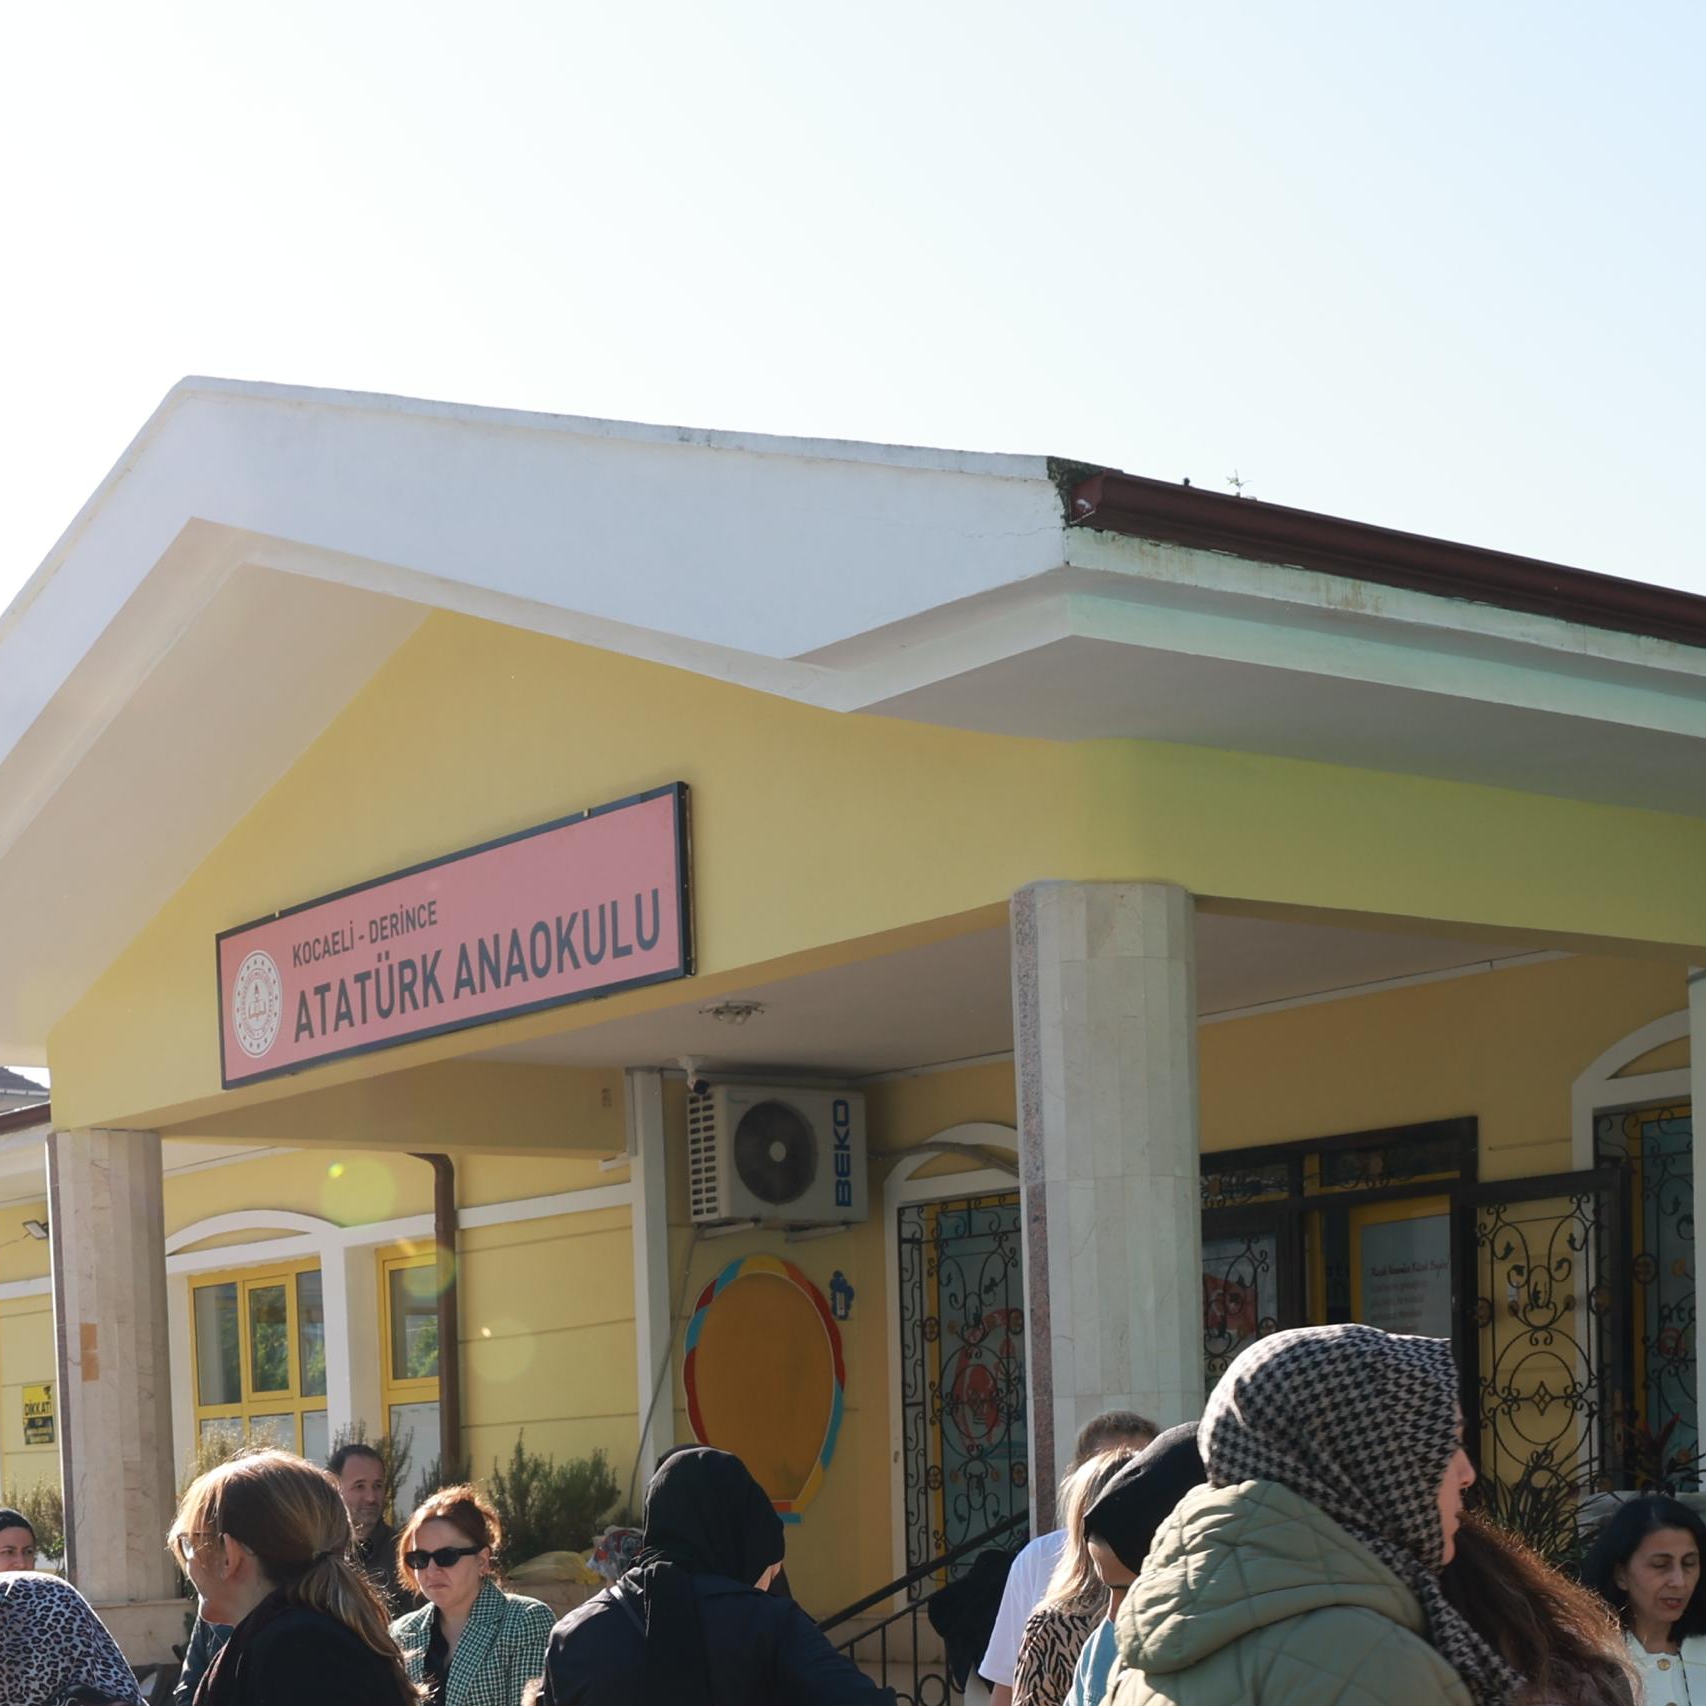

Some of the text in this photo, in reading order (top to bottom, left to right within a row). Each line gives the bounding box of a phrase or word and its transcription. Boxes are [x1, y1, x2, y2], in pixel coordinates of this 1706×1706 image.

[292, 921, 355, 969] KOCAELİ
[369, 900, 439, 945] DERİNCE
[294, 950, 445, 1044] ATATÜRK
[453, 888, 661, 1001] ANAOKULU
[833, 1099, 852, 1207] BEKO
